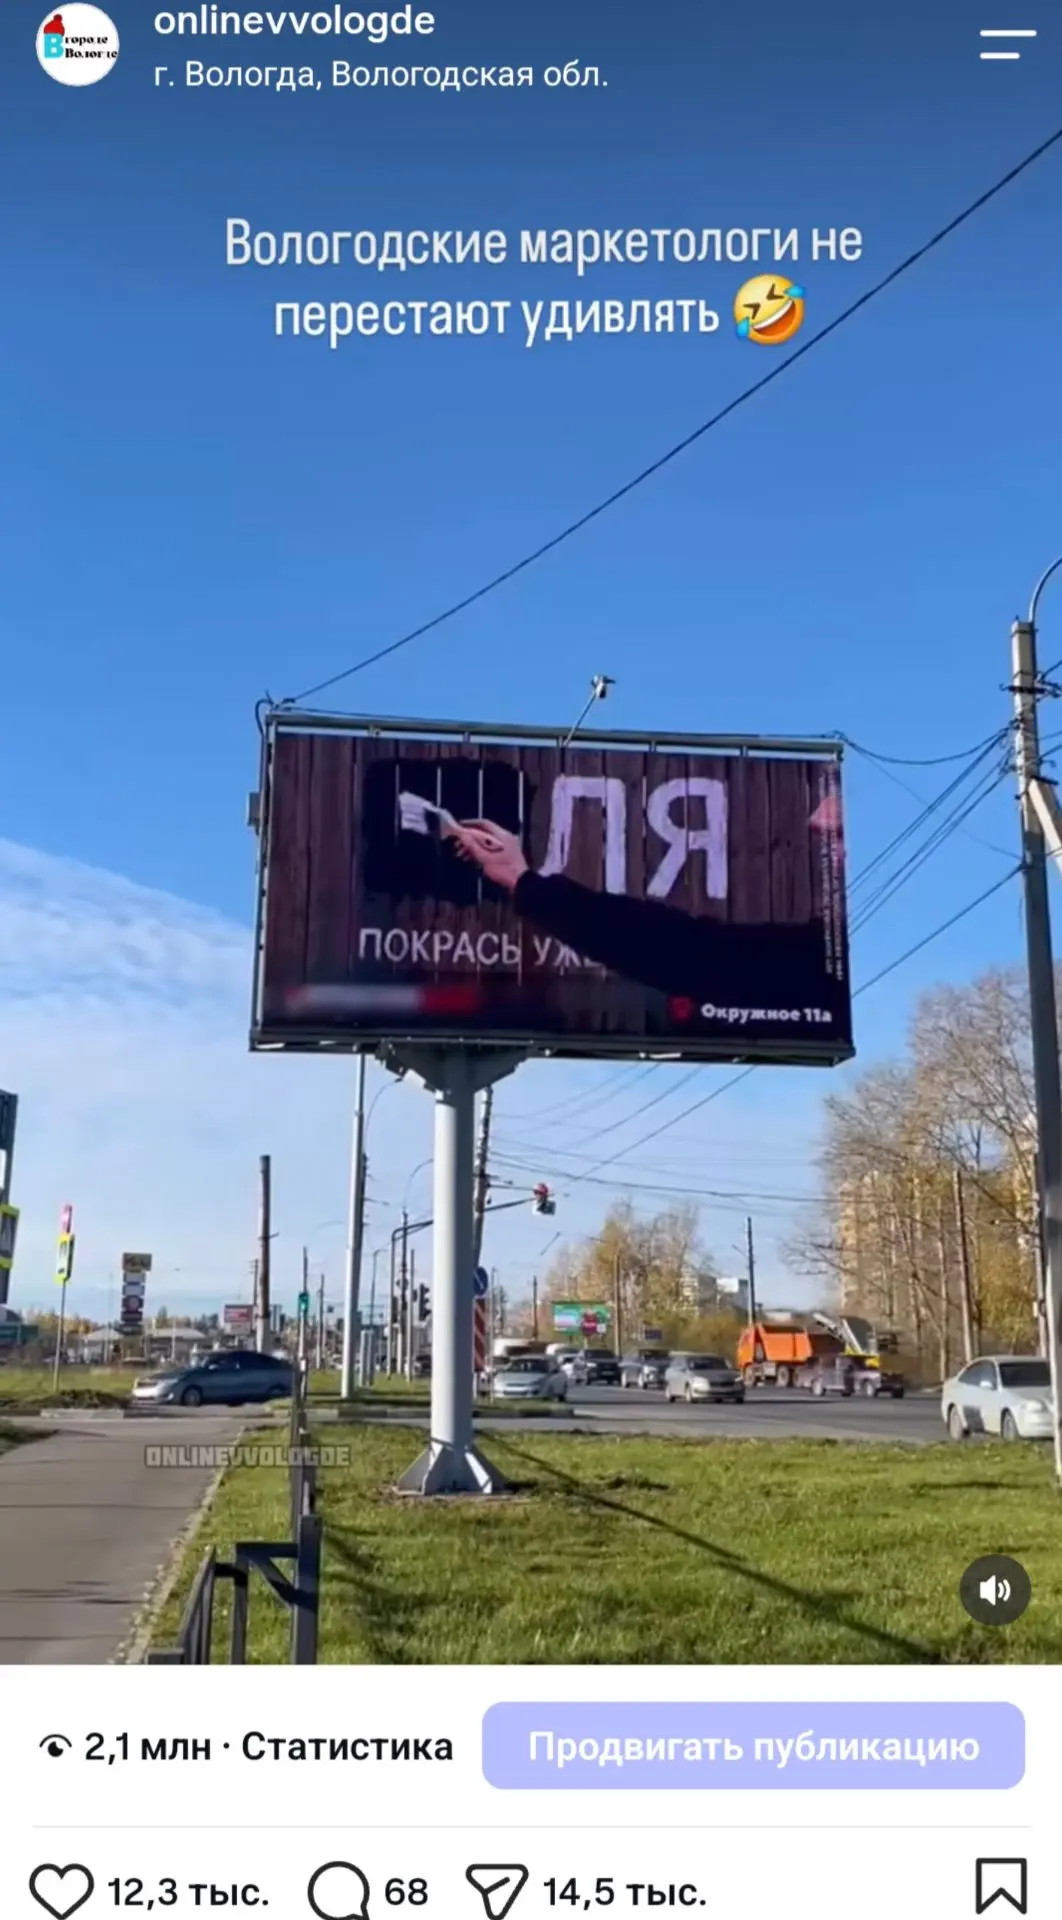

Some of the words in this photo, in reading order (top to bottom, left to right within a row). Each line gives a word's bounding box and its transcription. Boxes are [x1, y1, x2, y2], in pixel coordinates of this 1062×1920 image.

[537, 775, 728, 899] ЛЯ
[358, 928, 522, 966] ПОКРАСЬ
[533, 934, 607, 970] УЖ
[701, 1003, 800, 1025] Окружное
[803, 1008, 833, 1023] 11а
